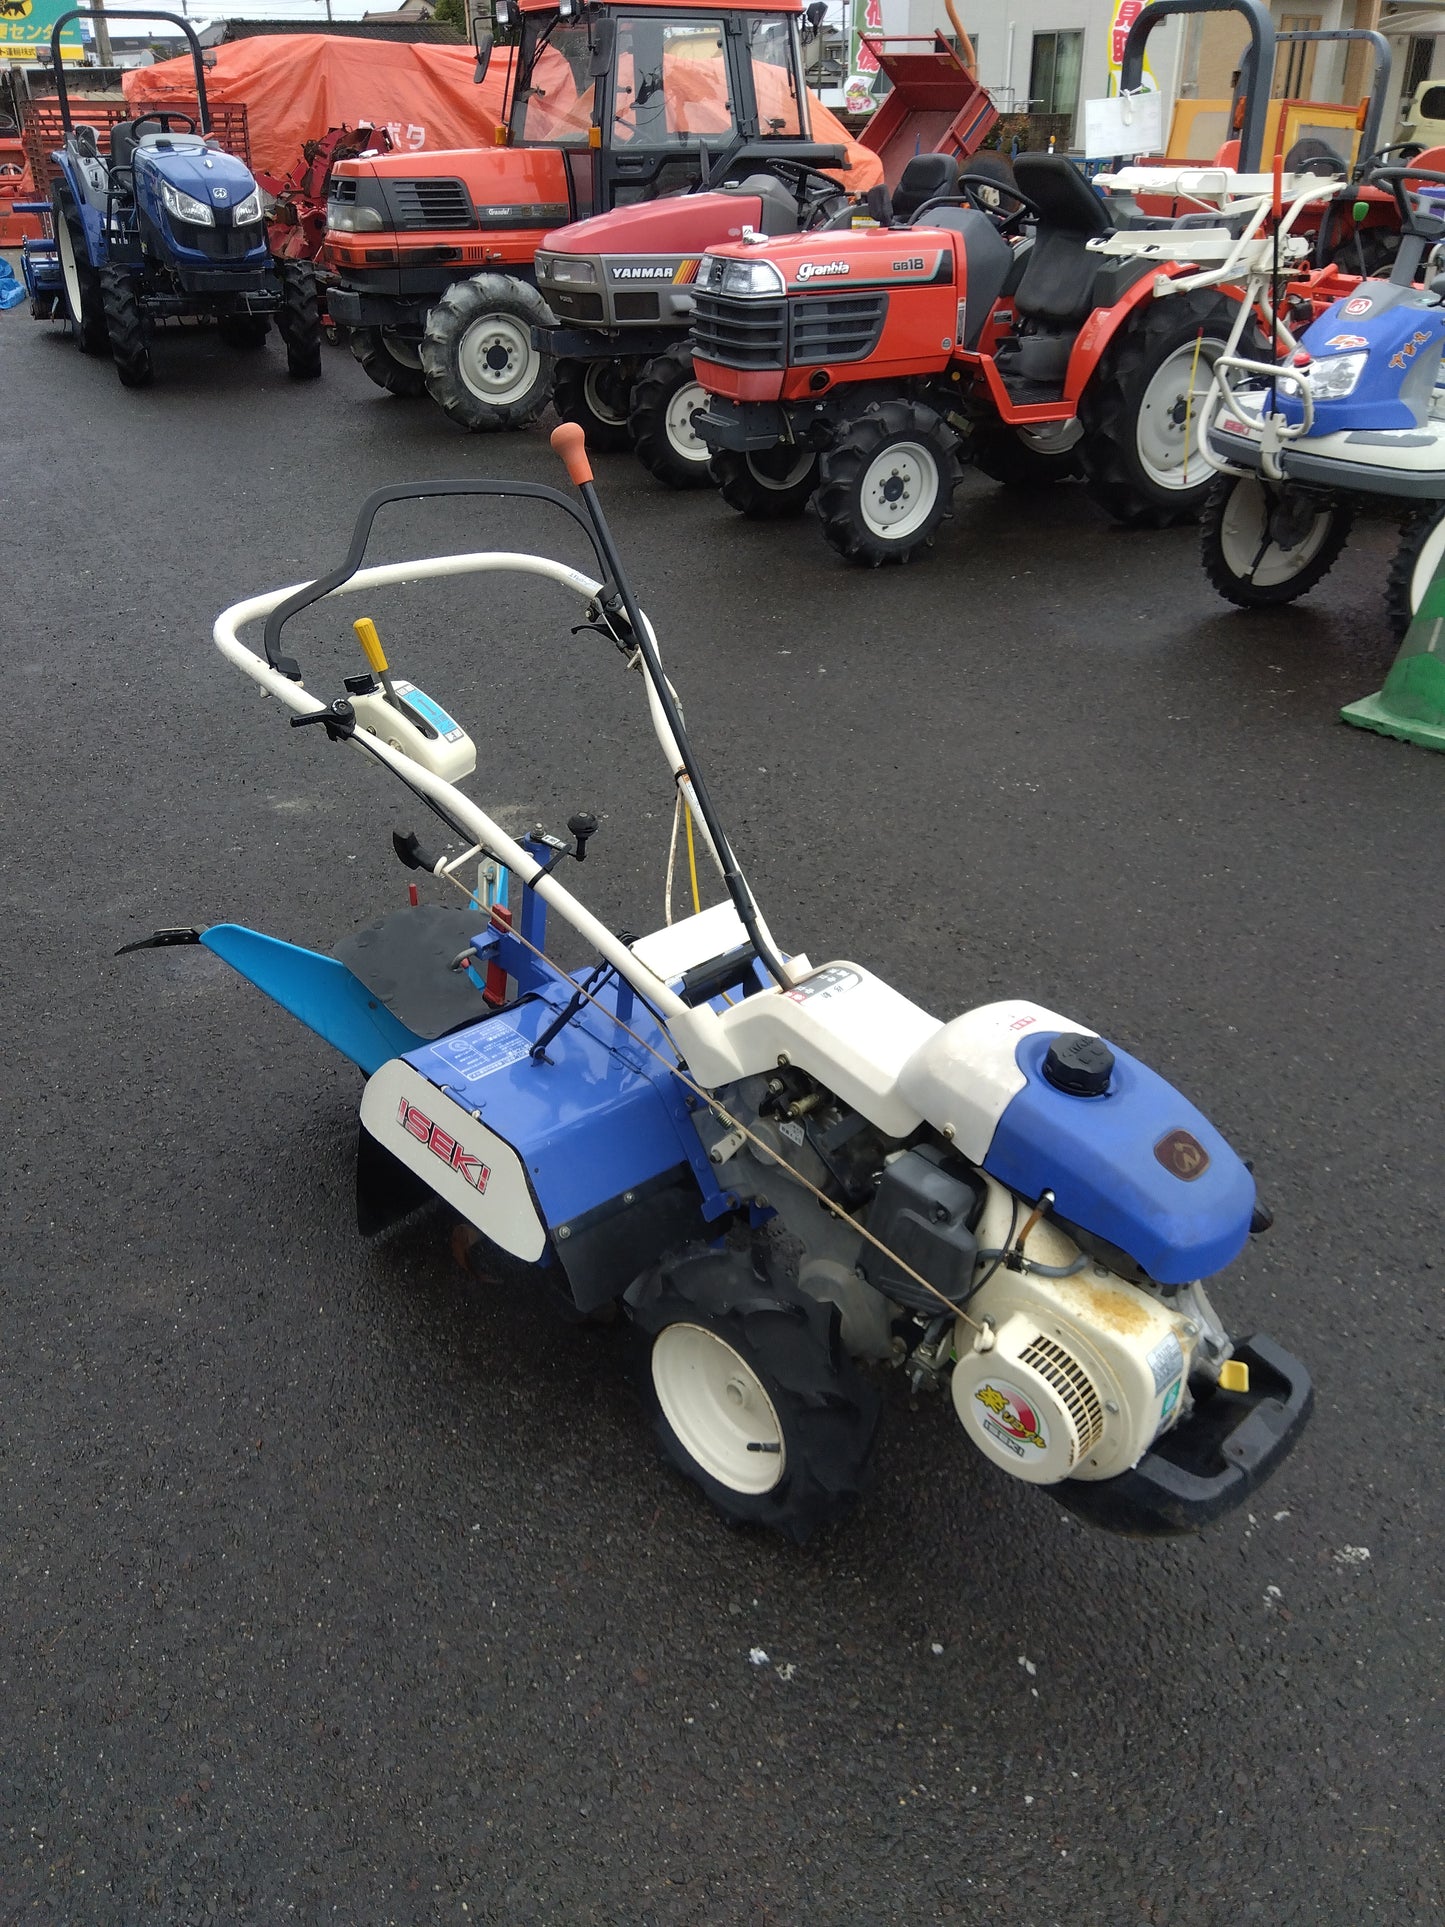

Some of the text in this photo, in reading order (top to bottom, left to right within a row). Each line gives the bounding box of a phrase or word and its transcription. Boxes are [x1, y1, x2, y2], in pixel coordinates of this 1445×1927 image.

[893, 258, 925, 271] GB18
[612, 267, 674, 279] YANMAR
[396, 1096, 492, 1196] ISEKI
